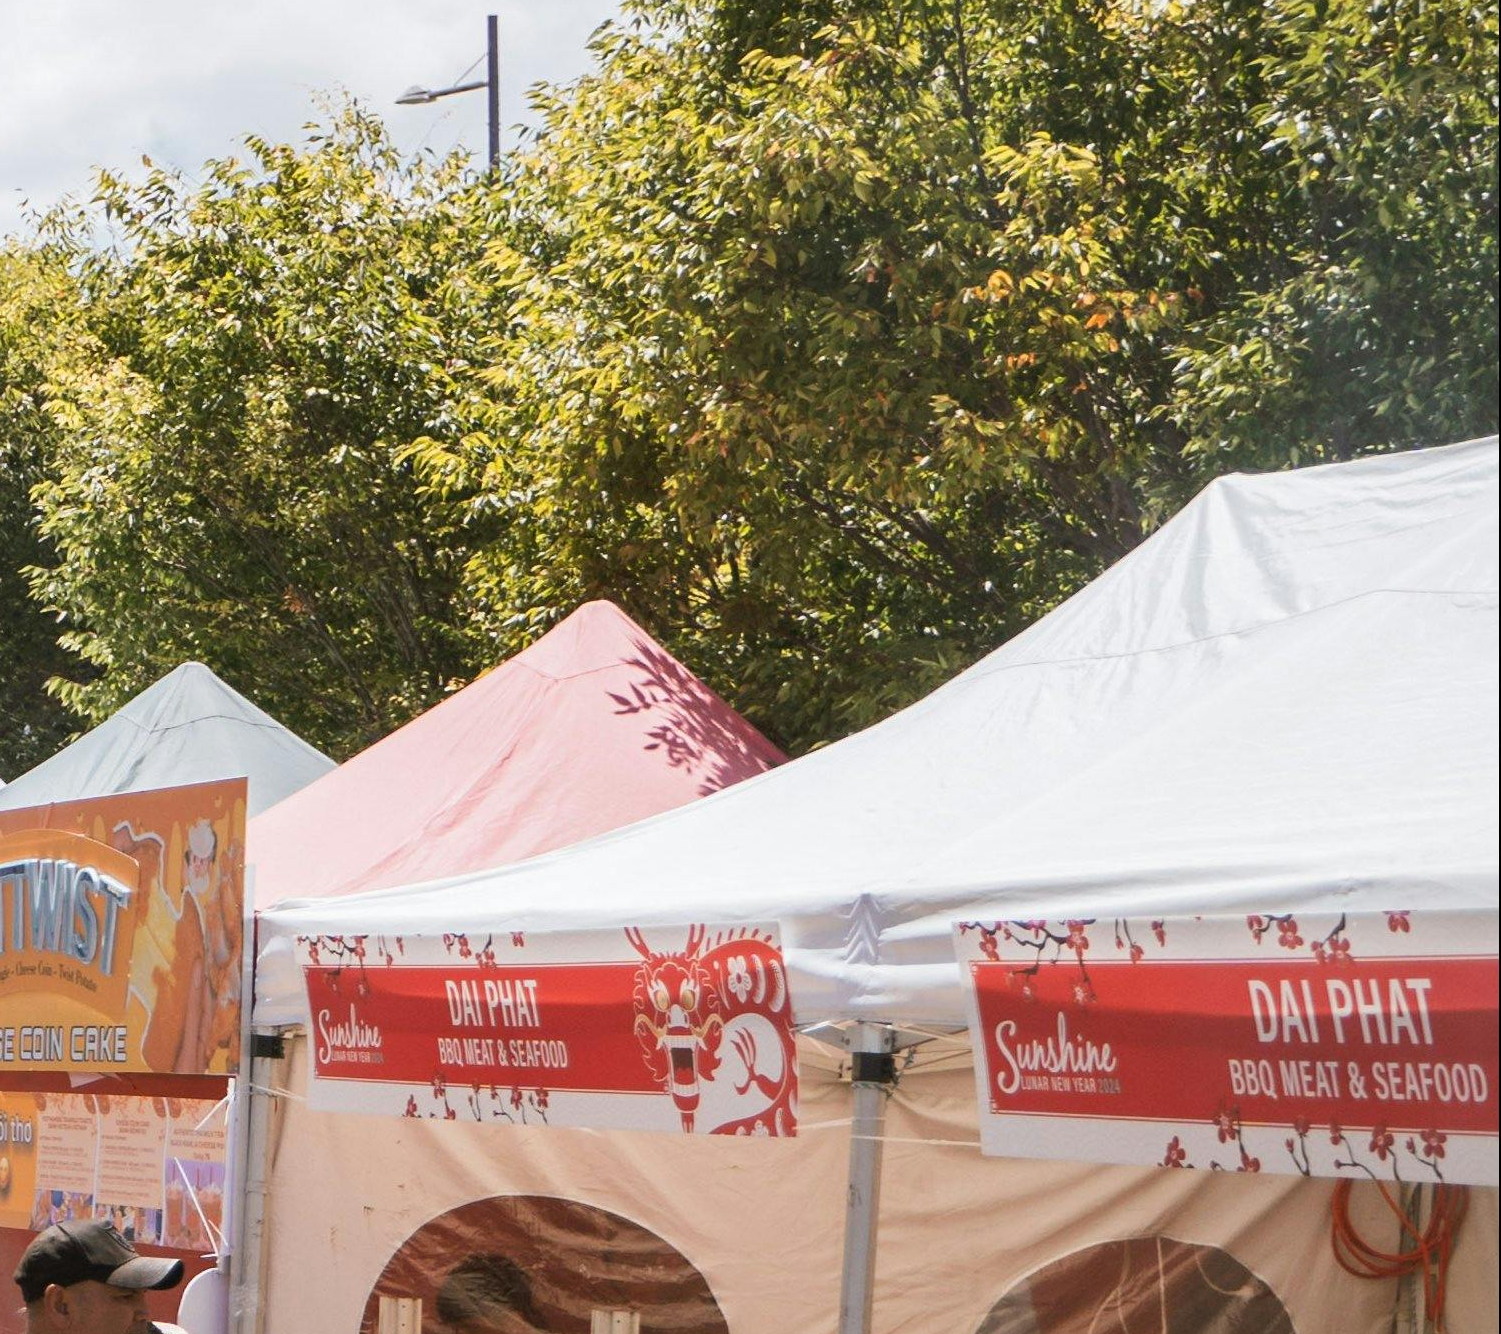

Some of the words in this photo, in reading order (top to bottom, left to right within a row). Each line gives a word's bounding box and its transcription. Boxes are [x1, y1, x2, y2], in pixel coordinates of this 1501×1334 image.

[445, 980, 485, 1027] DAI
[487, 979, 541, 1028] PHAT
[1248, 979, 1319, 1044] DAI
[1330, 978, 1434, 1046] PHAT
[19, 1026, 64, 1062] COIN
[70, 1026, 128, 1063] CAKE
[317, 1003, 383, 1065] Sunshine
[439, 1038, 463, 1068] BBQ
[464, 1039, 495, 1067] MEAT
[498, 1040, 508, 1067] &
[510, 1039, 568, 1069] SEAFOOD
[995, 1011, 1117, 1094] Sunshine
[331, 1050, 347, 1062] LUNAR
[347, 1051, 357, 1062] NEW
[358, 1052, 371, 1063] YEAR
[1021, 1076, 1049, 1092] LUNAR
[1051, 1077, 1071, 1092] NEW
[1072, 1078, 1097, 1093] YEAR
[1097, 1079, 1121, 1095] 2024
[1228, 1060, 1279, 1099] BBQ
[1280, 1061, 1344, 1099] MEAT
[1349, 1063, 1367, 1100] &
[1373, 1062, 1489, 1104] SEAFOOD
